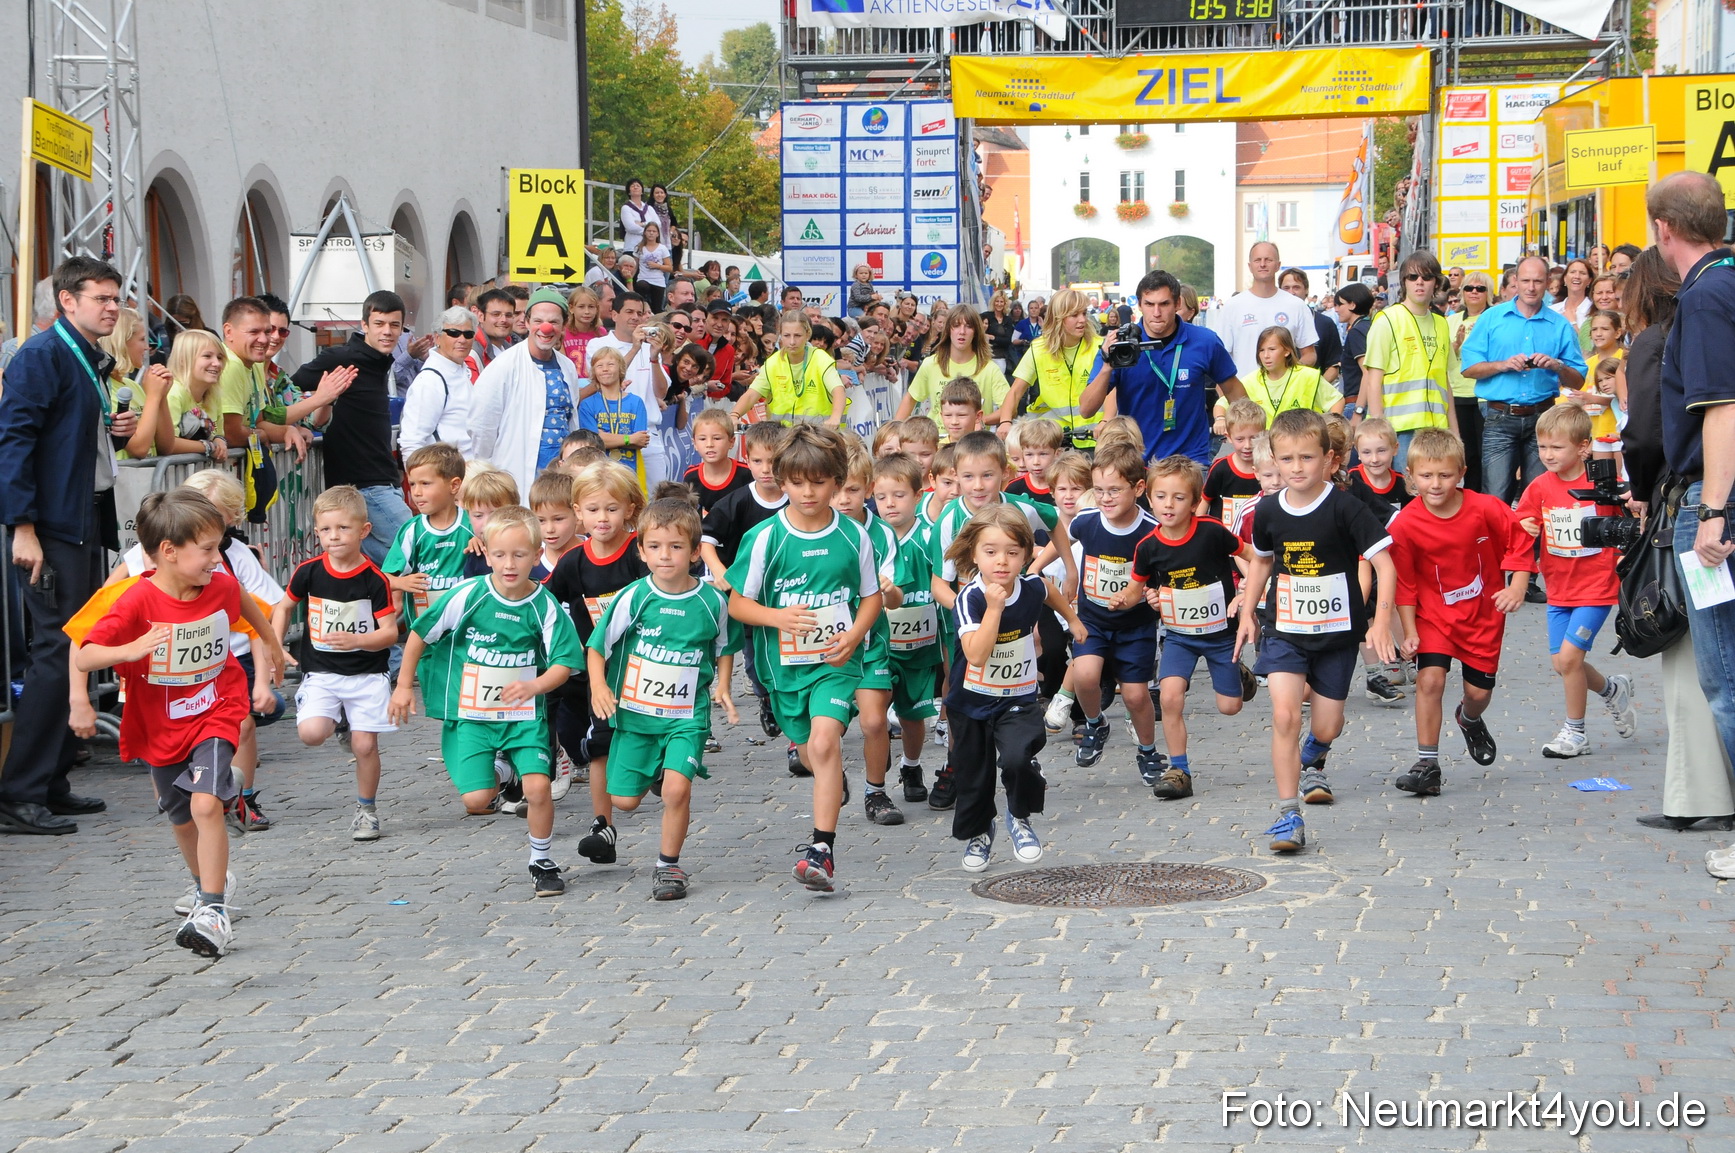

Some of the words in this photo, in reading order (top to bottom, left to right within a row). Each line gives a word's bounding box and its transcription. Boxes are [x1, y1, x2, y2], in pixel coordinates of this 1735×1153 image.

[1135, 67, 1241, 106] ZIEL
[1300, 83, 1356, 93] Neumarkter
[1359, 82, 1403, 92] Stadtlauf
[974, 89, 1029, 98] Neumarkter
[1032, 91, 1076, 100] Stadtlauf
[46, 118, 74, 141] Treffpunkt
[865, 123, 885, 131] vedes
[35, 130, 82, 167] Bambinilauf
[850, 149, 884, 161] MCM
[916, 147, 950, 157] Sinupret
[1571, 144, 1648, 159] Schnupper-
[916, 158, 937, 166] forte
[1598, 160, 1622, 172] lauf
[520, 173, 577, 194] Block
[913, 189, 940, 197] swn
[526, 203, 569, 258] A
[923, 268, 944, 276] vedes
[1550, 513, 1572, 523] David
[1555, 528, 1581, 542] 710
[802, 548, 829, 557] DERBYSTAR
[1100, 563, 1126, 576] Marcel
[773, 573, 808, 592] Sport
[1100, 579, 1129, 593] 708
[1293, 581, 1321, 593] Jonas
[779, 585, 850, 608] Münch
[1456, 587, 1475, 598] DEHN
[324, 604, 341, 616] Karl
[659, 607, 686, 617] DERBYSTAR
[1178, 603, 1219, 620] 7290
[1295, 597, 1342, 615] 7096
[494, 611, 521, 623] DERBYSTAR
[176, 625, 211, 641] Florian
[325, 620, 368, 634] 7045
[635, 622, 662, 639] Sport
[801, 621, 847, 645] 7238
[890, 618, 930, 635] 7241
[465, 626, 497, 644] Sport
[177, 637, 224, 665] 7035
[467, 644, 536, 667] Münch
[635, 639, 704, 666] Münch
[990, 649, 1015, 659] Linus
[989, 659, 1032, 679] 7027
[482, 685, 504, 701] 72
[642, 678, 689, 699] 7244
[185, 695, 206, 711] DEHN
[663, 708, 692, 716] PFLEIDERER
